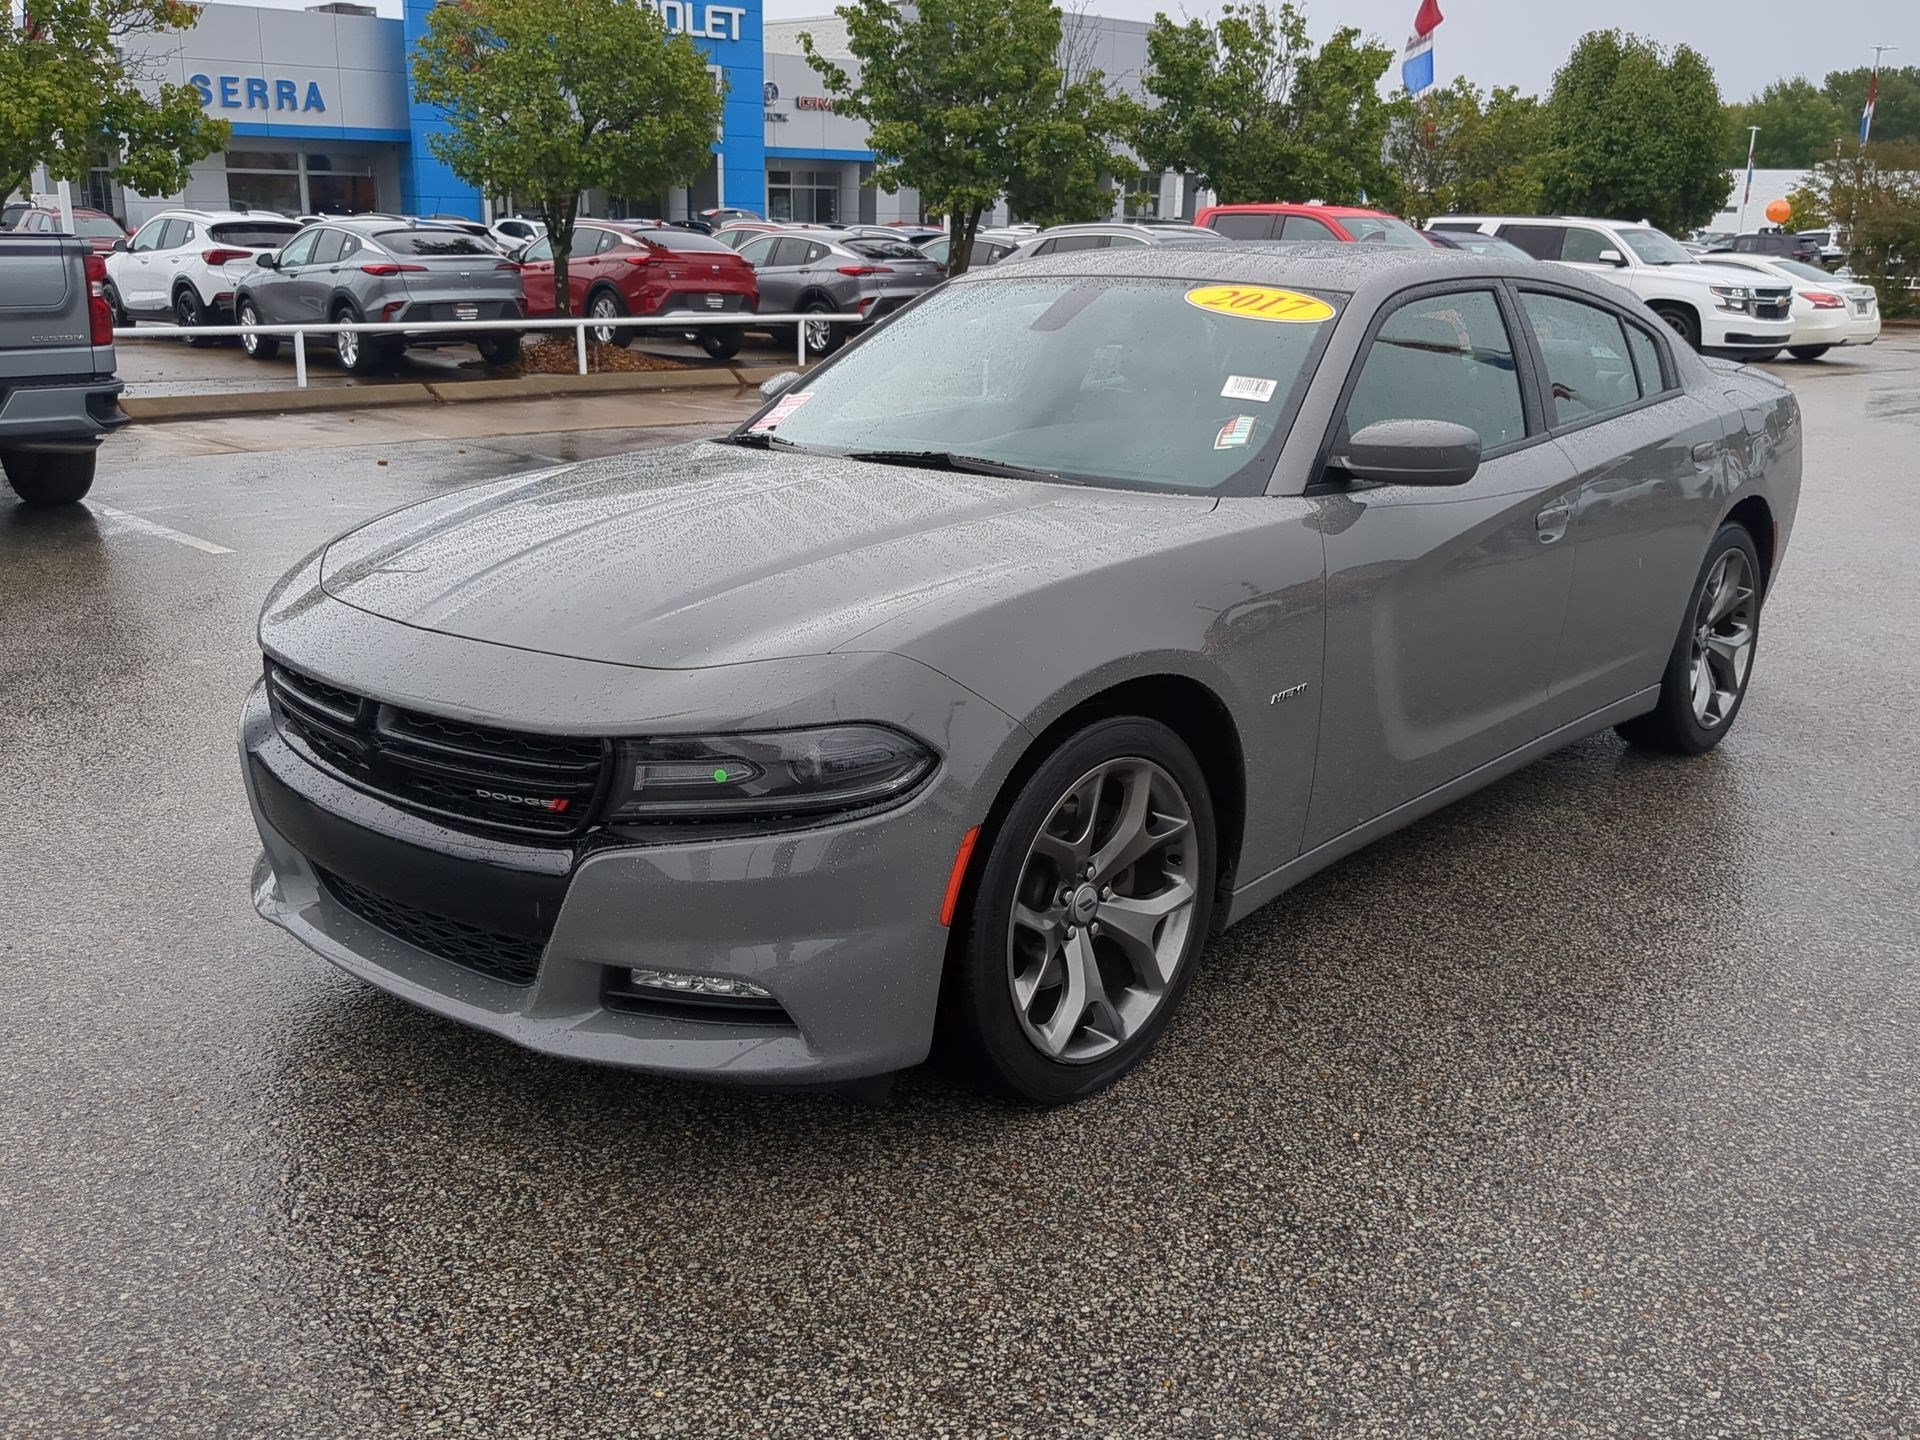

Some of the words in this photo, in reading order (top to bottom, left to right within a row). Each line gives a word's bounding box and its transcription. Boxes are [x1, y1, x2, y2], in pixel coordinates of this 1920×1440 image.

[189, 74, 326, 112] SERRA
[798, 96, 834, 111] GM
[1202, 290, 1315, 314] 2017
[31, 334, 85, 342] CUSTOM
[476, 789, 557, 809] DODGE
